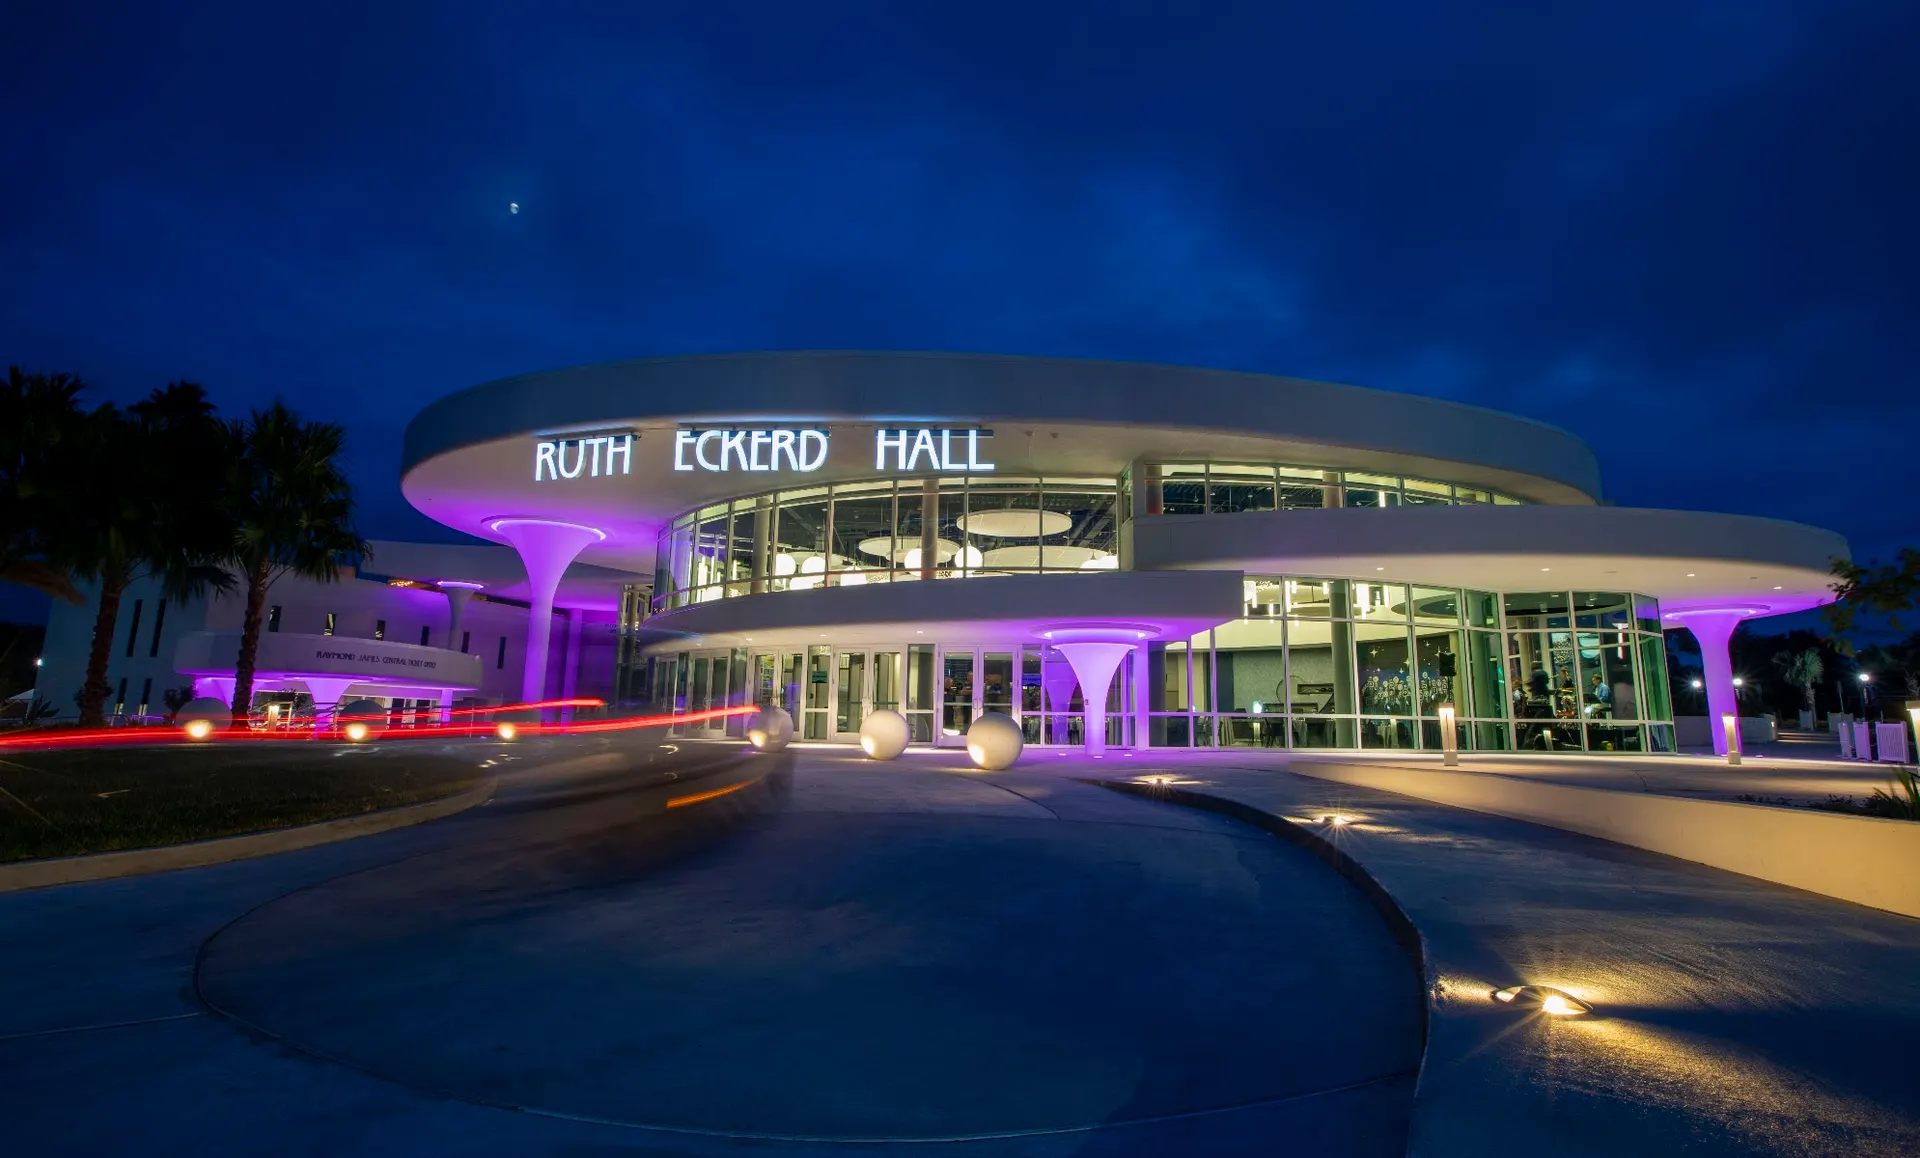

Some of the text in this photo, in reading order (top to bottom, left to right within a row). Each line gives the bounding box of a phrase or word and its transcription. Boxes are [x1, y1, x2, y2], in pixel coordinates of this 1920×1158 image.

[534, 429, 995, 481] RUTH ECKERD HALL
[316, 651, 356, 661] RAYMOND
[357, 653, 380, 663] JAMES
[382, 656, 407, 666] CENTRAL
